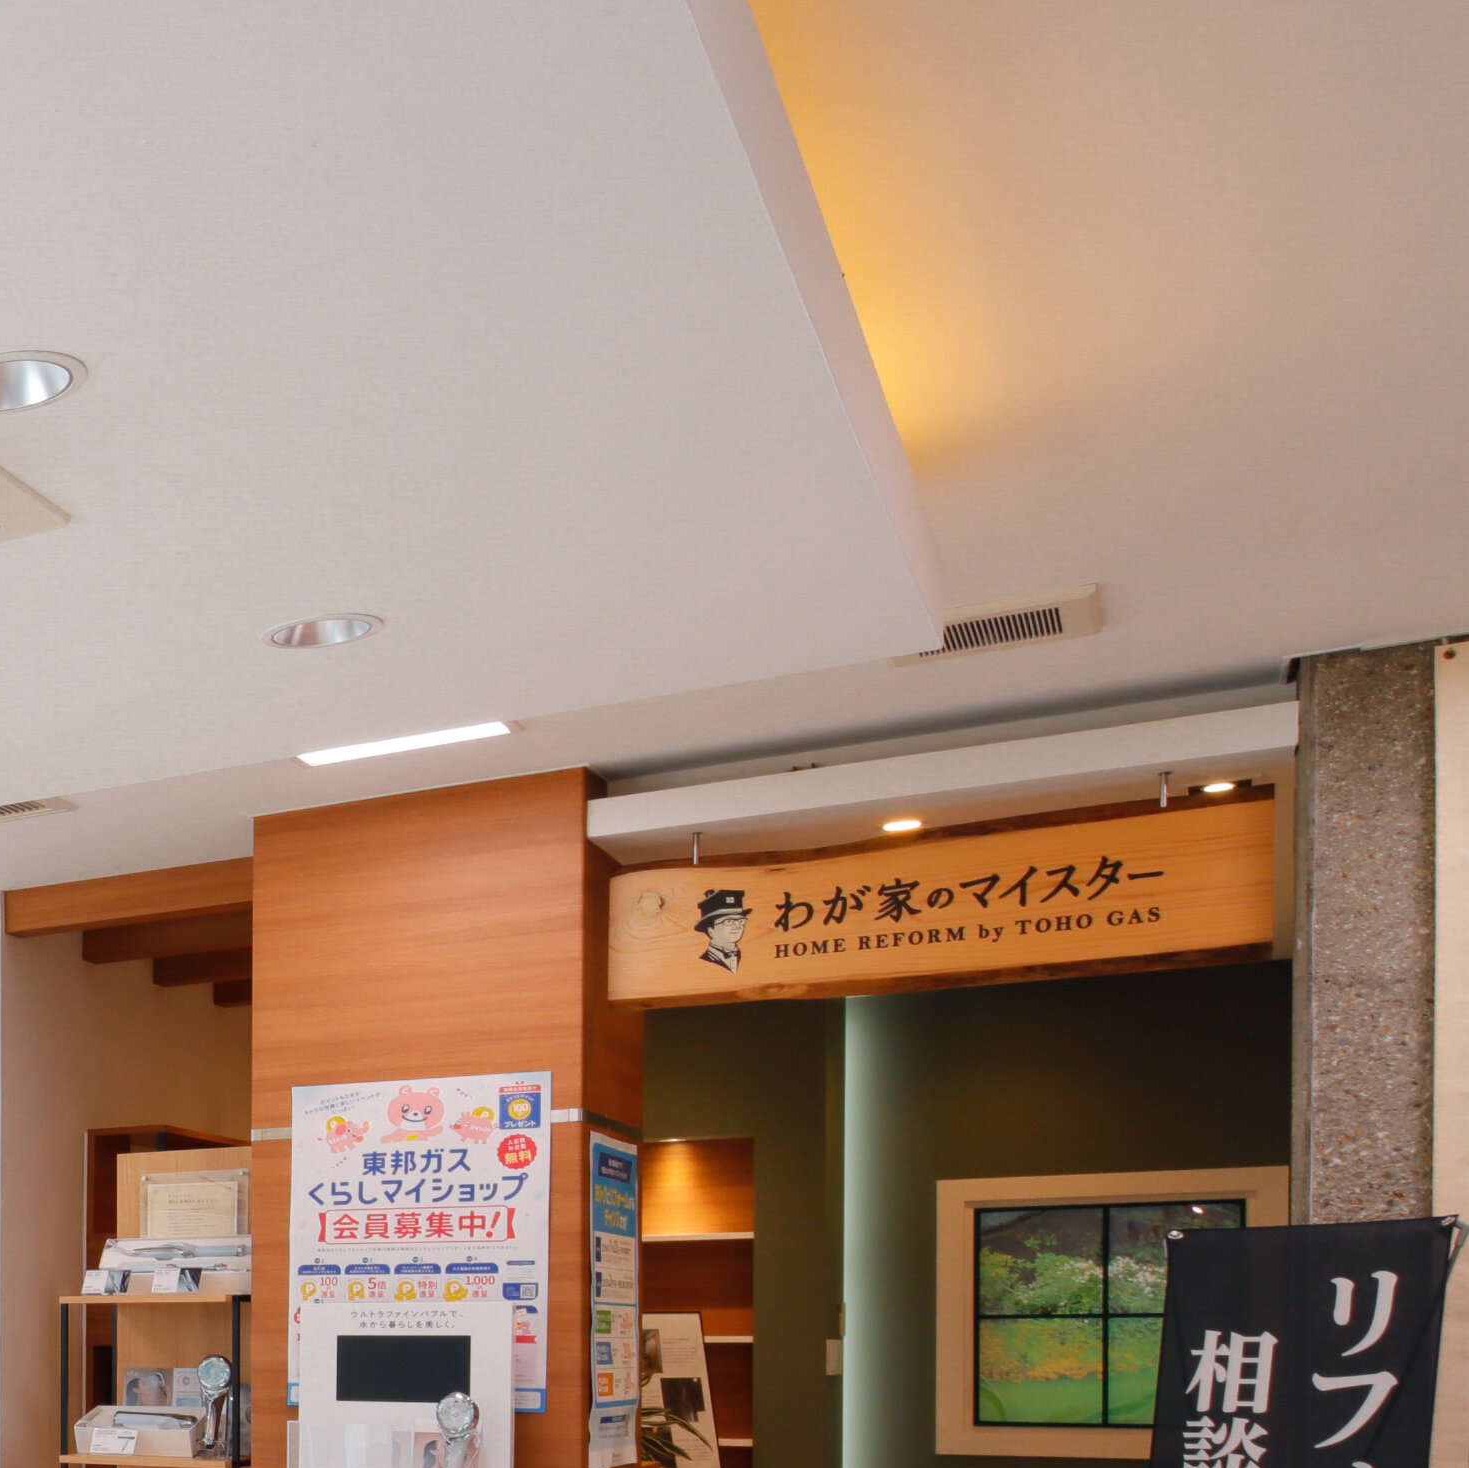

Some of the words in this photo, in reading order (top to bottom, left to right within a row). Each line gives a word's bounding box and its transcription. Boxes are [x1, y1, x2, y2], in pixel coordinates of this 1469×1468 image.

[774, 855, 1164, 932] わが家のマイスター
[775, 938, 846, 958] HOME
[858, 926, 966, 950] REFORM
[978, 924, 1005, 942] by
[1015, 913, 1094, 935] TOHO
[1107, 906, 1162, 926] GAS
[504, 1120, 537, 1129] プレゼント
[362, 1148, 471, 1176] 東邦ガス
[504, 1149, 532, 1165] 無料
[308, 1172, 529, 1206] くらしマイショップ
[333, 1211, 501, 1240] 会員募集中!
[320, 1276, 338, 1287] 100
[417, 1281, 437, 1290] 特別
[465, 1275, 496, 1286] 1,000
[350, 1309, 464, 1319] ウルトラファインバブルで、
[359, 1320, 457, 1329] 水から暮らしを美しく。
